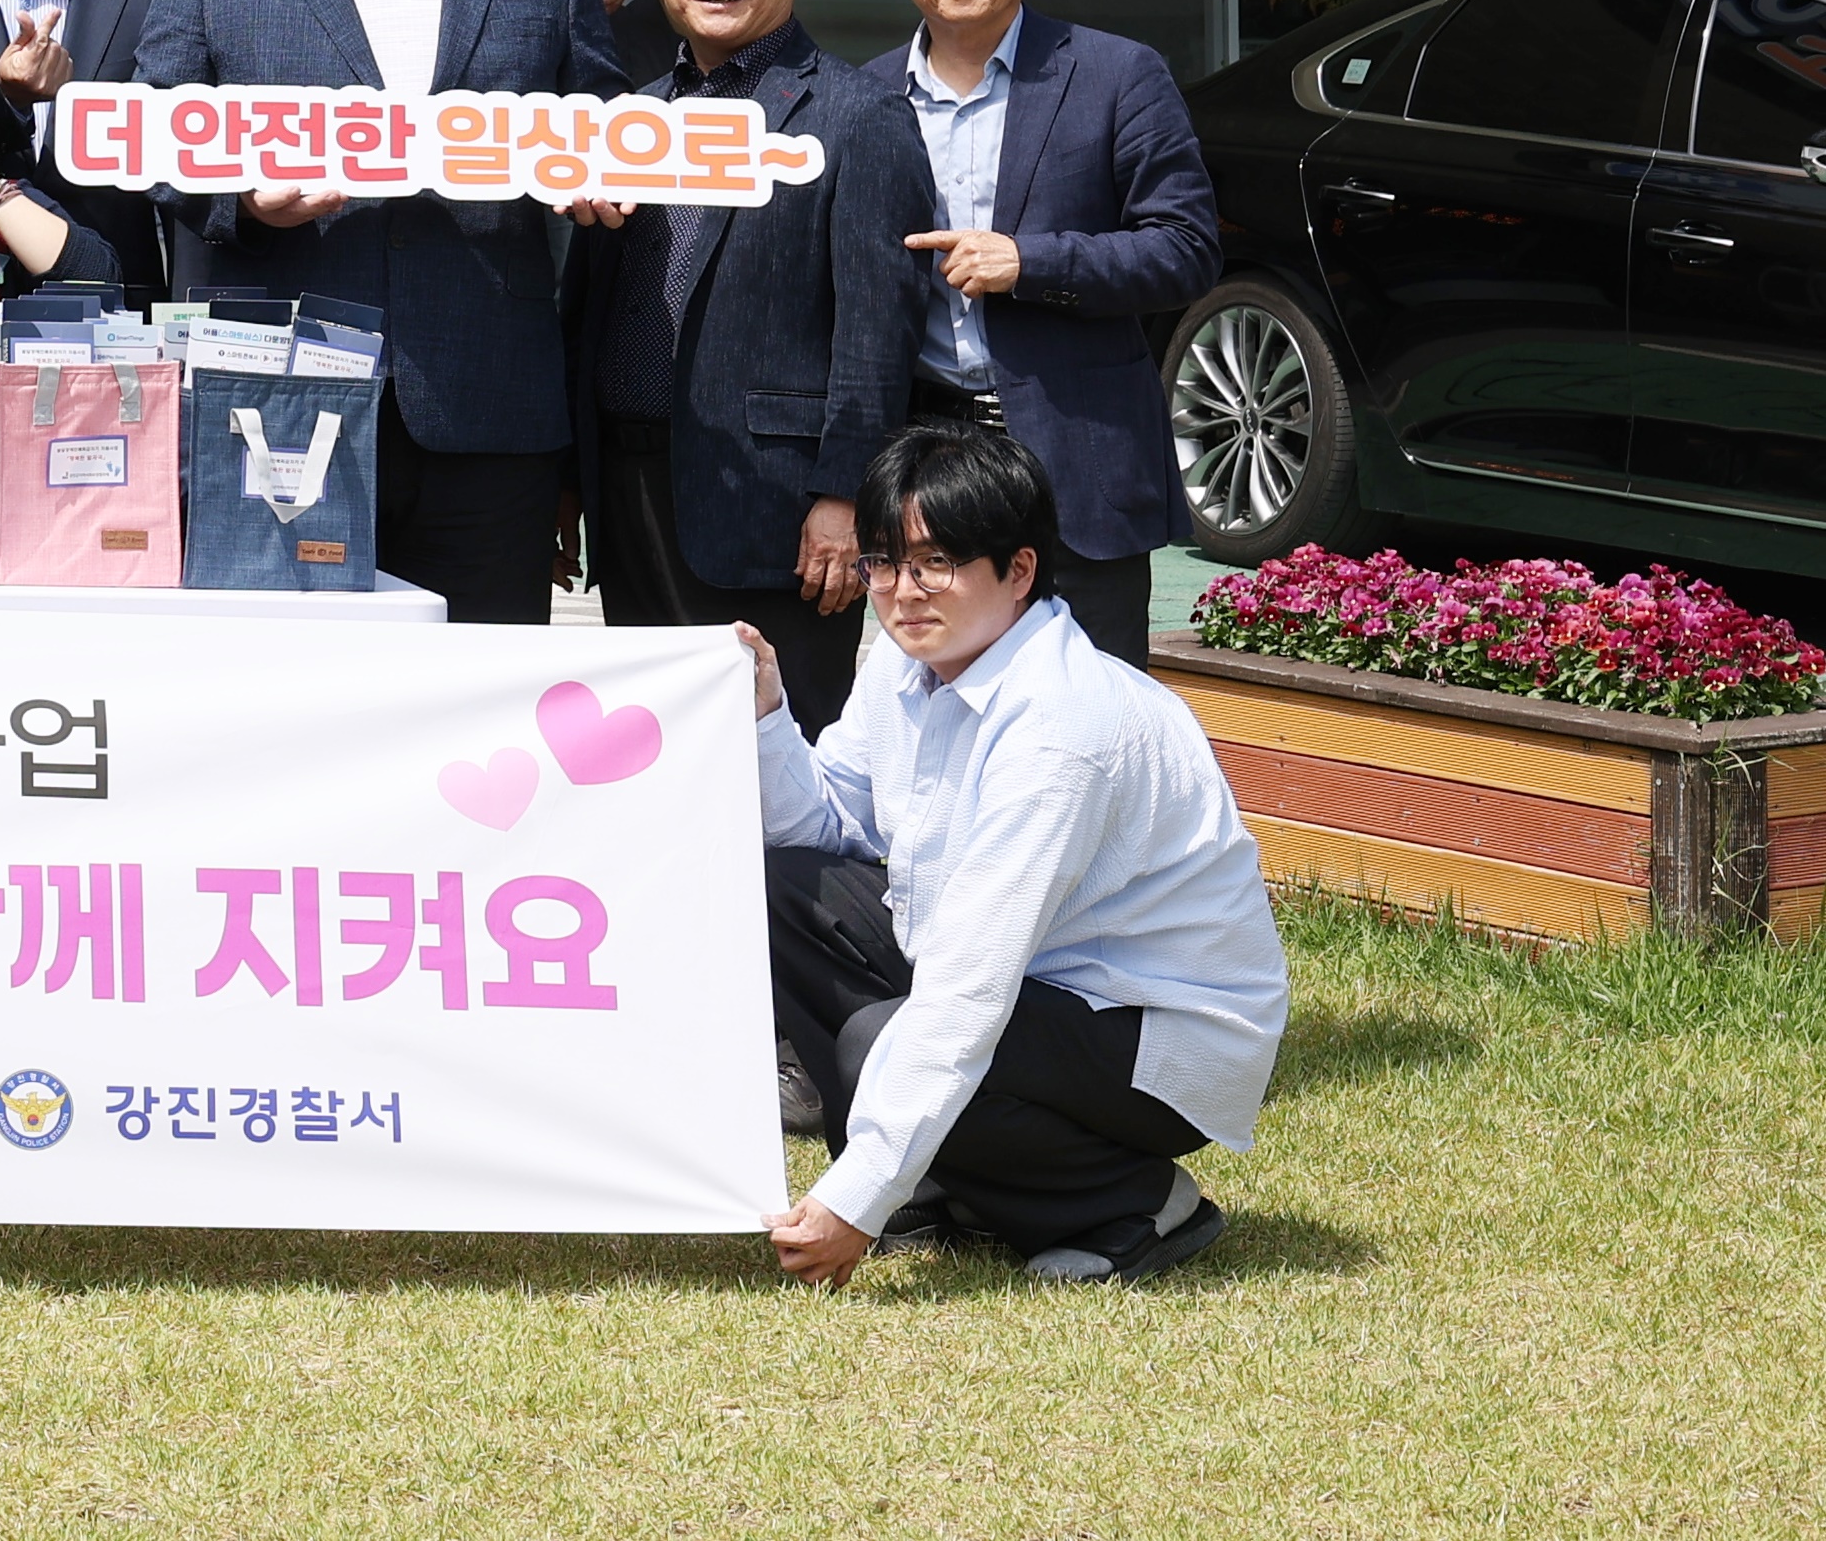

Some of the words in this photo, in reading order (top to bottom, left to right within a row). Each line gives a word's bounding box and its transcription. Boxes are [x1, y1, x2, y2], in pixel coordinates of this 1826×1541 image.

[71, 98, 142, 176] 더
[170, 101, 415, 182] 안전한
[437, 106, 809, 192] 일상으로~
[116, 334, 145, 342] SmartThings
[195, 865, 618, 1011] 지켜요
[21, 1136, 49, 1147] POLICE
[104, 1083, 404, 1144] 강진경찰서
